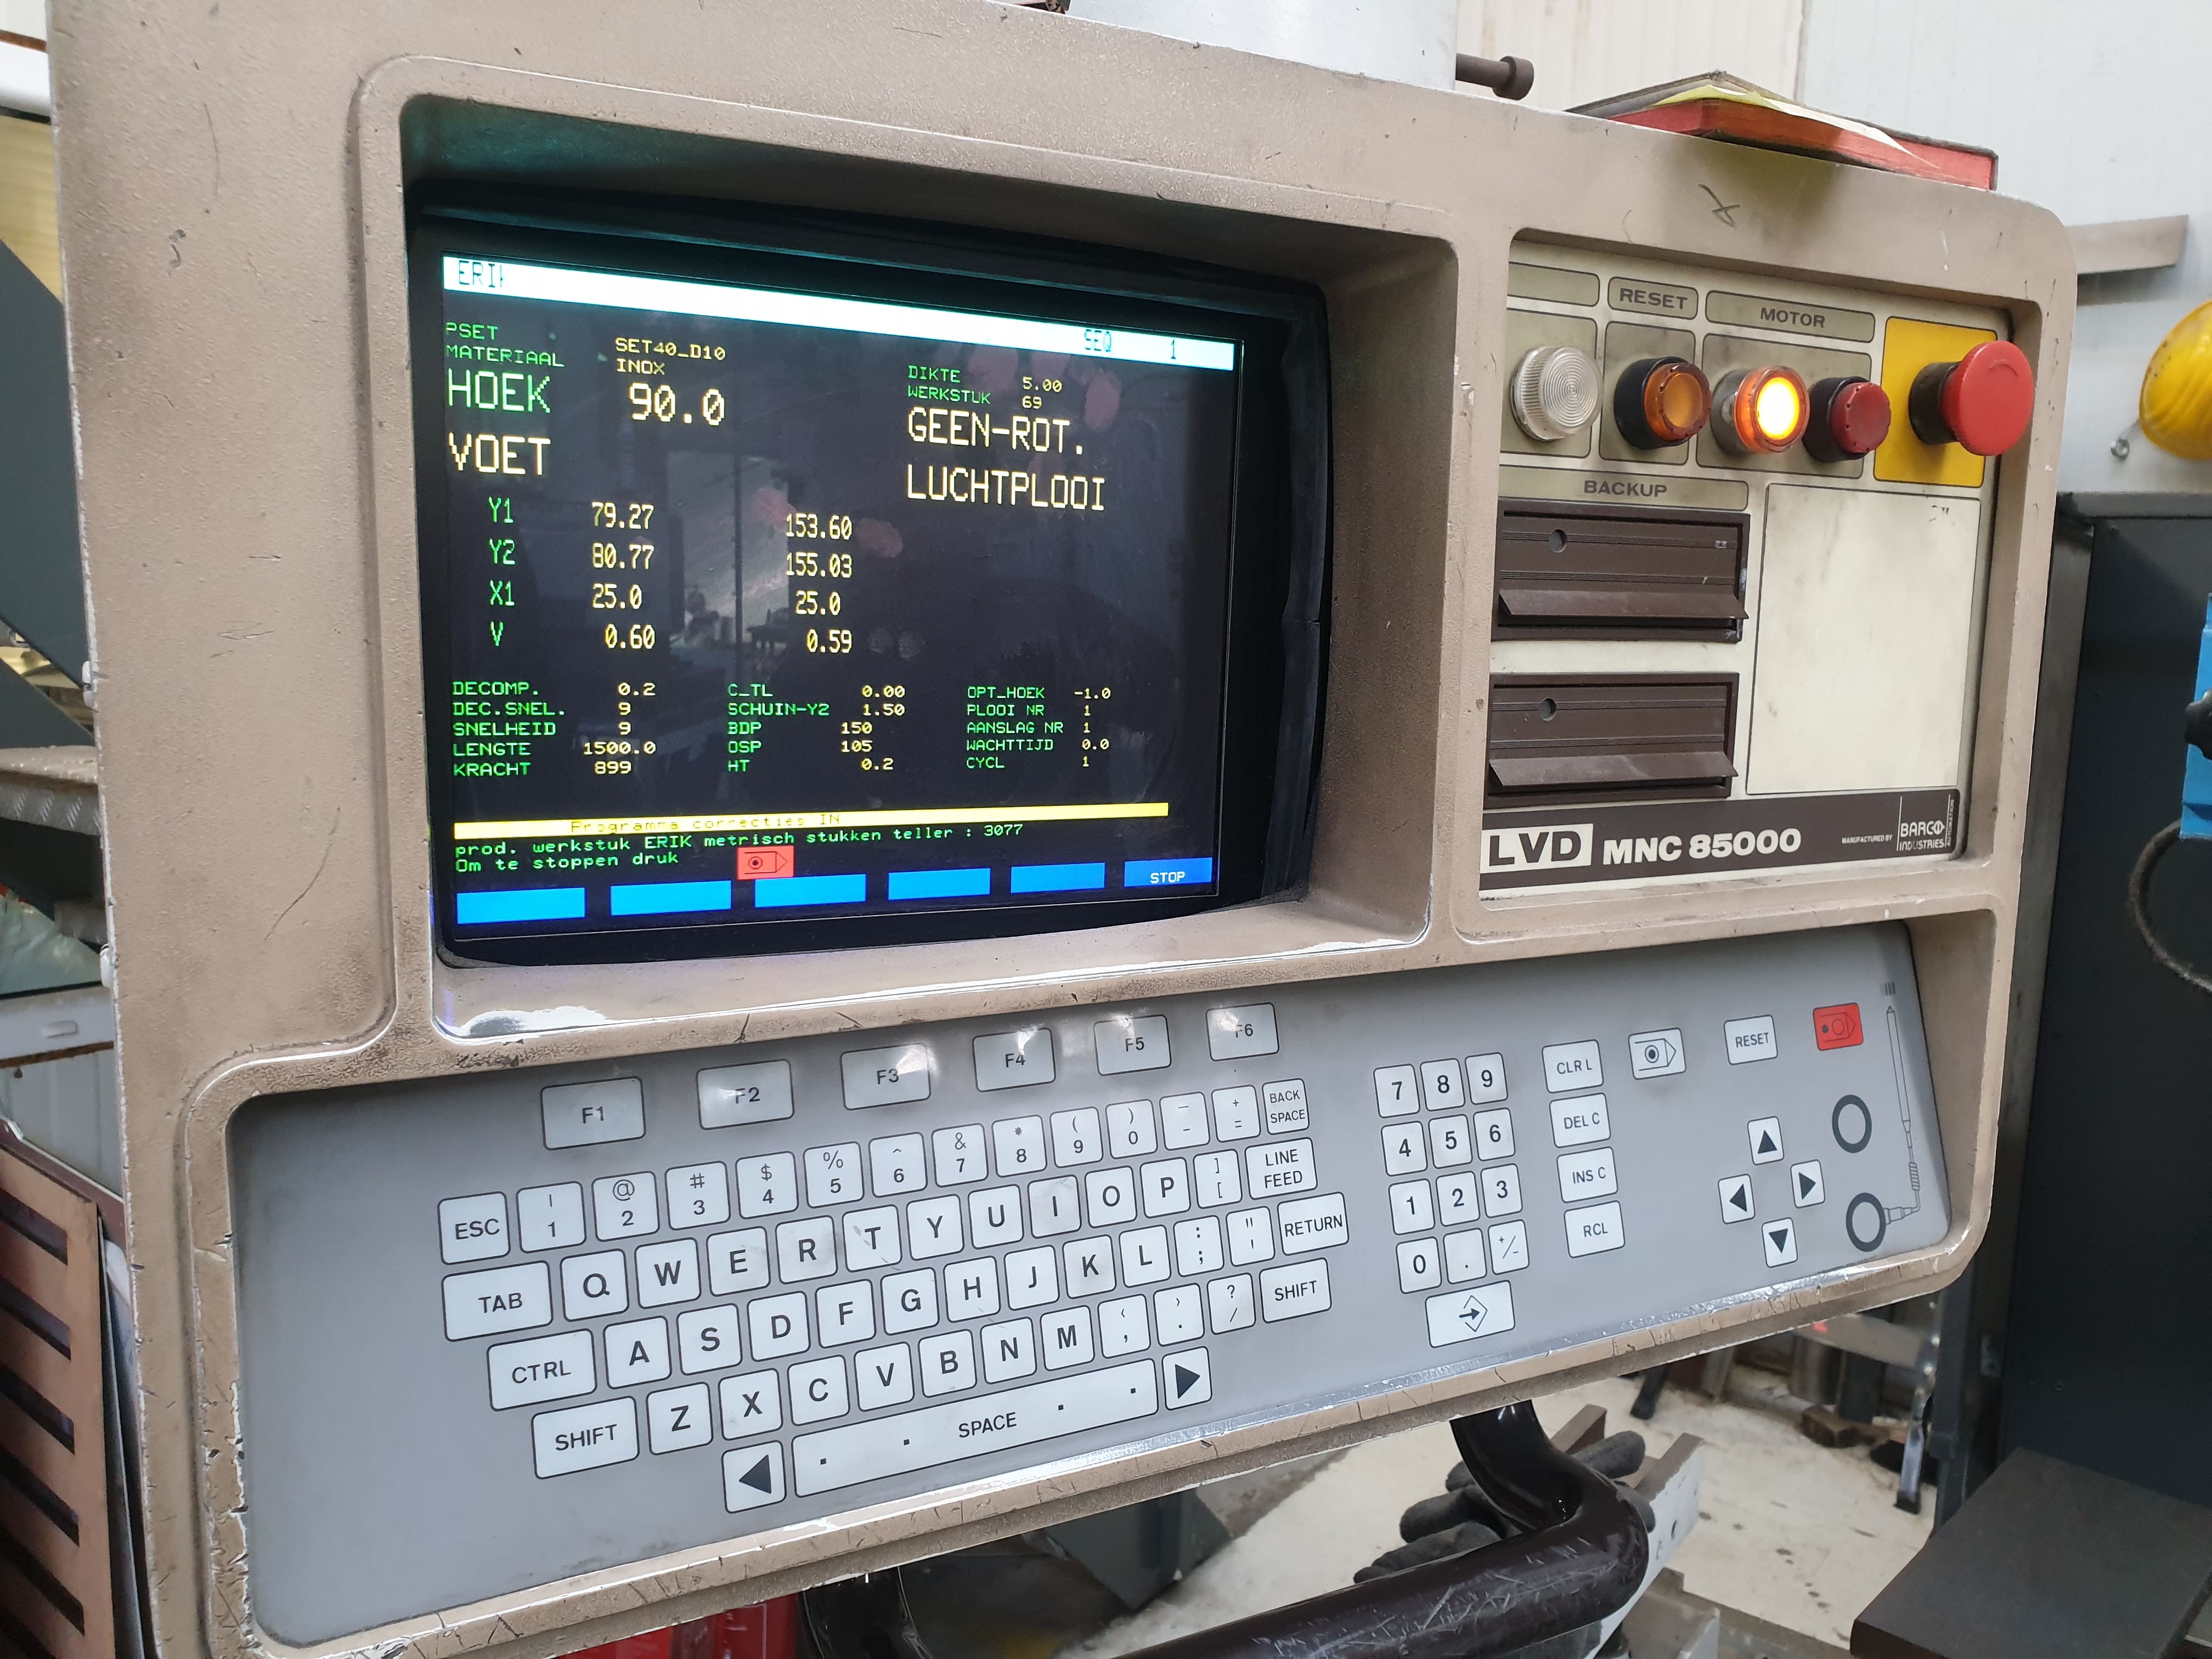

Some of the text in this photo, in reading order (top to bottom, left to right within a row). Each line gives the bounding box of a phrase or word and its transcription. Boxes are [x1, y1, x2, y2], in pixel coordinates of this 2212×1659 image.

[1620, 287, 1688, 310] RESET
[1760, 308, 1826, 329] MOTOR
[445, 322, 499, 340] PSET
[446, 345, 565, 367] MATERIAAL
[616, 337, 726, 360] SET40_D10
[1170, 338, 1177, 360] 1
[617, 358, 665, 375] INOX
[908, 365, 961, 383] DIKTE
[448, 368, 550, 414] HOEK
[1023, 376, 1062, 393] 5.00
[629, 382, 725, 426] 90.0
[908, 385, 991, 404] WERKSTUK
[1022, 395, 1042, 409] 69
[908, 407, 1084, 455] GEEN-ROT.
[449, 432, 551, 476] VOET
[907, 464, 1105, 511] LUCHTPLOOI
[1584, 478, 1667, 497] BACKUP
[488, 496, 514, 523] Y1
[591, 501, 654, 529] 79.27
[785, 512, 852, 540] 153.60
[489, 538, 516, 565] Y2
[592, 543, 654, 569] 80.77
[786, 552, 853, 578] 155.03
[490, 580, 515, 606] X1
[592, 583, 642, 610] 25.0
[795, 590, 840, 616] 25.0
[490, 621, 504, 646] V
[605, 623, 655, 649] 0.60
[806, 629, 852, 653] 0.59
[452, 681, 538, 695] DECOMP.
[618, 682, 656, 696] 0.2
[728, 683, 774, 697] C_TL
[862, 685, 905, 698] 0.00
[968, 686, 1045, 699] OPT_HOEK
[1074, 687, 1111, 699] -1.0
[453, 702, 565, 716] DEC.SNEL.
[618, 702, 631, 715] 9
[728, 702, 830, 716] SCHUIN-Y2
[863, 703, 905, 716] 1.50
[967, 704, 1045, 716] PLOOI NR
[1084, 705, 1091, 716] 1
[453, 722, 556, 736] SNELHEID
[618, 721, 631, 735] 9
[728, 721, 761, 735] BDP
[841, 721, 872, 734] 150
[967, 721, 1063, 733] AANSLAG NR
[1084, 722, 1091, 733] 1
[453, 742, 531, 757] LENGTE
[584, 741, 656, 755] 1500.0
[728, 741, 761, 753] OSP
[841, 740, 873, 753] 105
[966, 739, 1053, 751] WACHTTIJD
[1082, 738, 1109, 750] 0.0
[454, 762, 531, 777] KRACHT
[595, 760, 631, 774] 899
[727, 759, 751, 772] HT
[861, 758, 894, 770] 0.2
[966, 757, 1005, 769] CYCL
[1083, 755, 1089, 767] 1
[571, 814, 840, 835] Programma correcties IN
[1900, 820, 1945, 837] BARCO
[455, 823, 1023, 858] prod. werkstuk ERIK metrisch stukken teller 3077
[1488, 831, 1581, 867] LVD
[1602, 828, 1801, 865] MNC 85000
[1842, 835, 1884, 844] MANUFACTURED
[1900, 839, 1944, 850] INDUSTRIES
[456, 851, 679, 872] Om te stoppen druk
[1150, 871, 1185, 884] STOP
[1235, 1023, 1254, 1038] F6
[1735, 1032, 1769, 1048] RESET
[1125, 1036, 1145, 1052] F5
[1005, 1053, 1026, 1068] F4
[1556, 1059, 1593, 1075] CLR L
[876, 1068, 899, 1085] F3
[1437, 1075, 1450, 1094] 8
[1481, 1069, 1493, 1088] 9
[735, 1086, 761, 1104] F2
[1269, 1090, 1300, 1104] BACK
[1391, 1081, 1402, 1101] 7
[582, 1105, 604, 1124] F1
[1270, 1109, 1306, 1124] SPACE
[1564, 1112, 1600, 1130] DEL C
[1128, 1131, 1138, 1145] 0
[1489, 1124, 1501, 1143] 6
[1016, 1148, 1027, 1163] 8
[1073, 1139, 1084, 1154] 9
[1399, 1138, 1412, 1157] 4
[1265, 1149, 1299, 1166] LINE
[894, 1168, 905, 1183] 6
[1264, 1170, 1302, 1189] FEED
[1572, 1166, 1606, 1184] INS C
[830, 1178, 842, 1194] 5
[1160, 1176, 1175, 1198] P
[1496, 1180, 1508, 1199] 3
[1102, 1185, 1120, 1207] O
[1452, 1188, 1465, 1207] 2
[693, 1199, 706, 1215] 3
[988, 1204, 1005, 1228] U
[621, 1210, 634, 1227] 2
[926, 1215, 943, 1239] Y
[1284, 1214, 1343, 1237] RETURN
[455, 1218, 500, 1240] ESC
[864, 1226, 881, 1250] T
[1583, 1222, 1609, 1238] RCL
[798, 1238, 817, 1262] R
[1138, 1245, 1153, 1266] L
[729, 1249, 748, 1274] E
[1082, 1254, 1099, 1278] K
[1413, 1254, 1426, 1274] 0
[653, 1260, 681, 1286] W
[583, 1273, 610, 1298] Q
[963, 1276, 981, 1301] H
[1274, 1280, 1317, 1301] SHIFT
[478, 1293, 523, 1313] TAB
[901, 1289, 921, 1312] G
[838, 1301, 853, 1325] F
[771, 1314, 791, 1339] D
[701, 1327, 720, 1352] S
[1057, 1324, 1077, 1350] M
[629, 1340, 650, 1366] A
[1000, 1337, 1019, 1362] N
[940, 1350, 958, 1374] B
[512, 1360, 572, 1384] CTRL
[876, 1362, 894, 1387] V
[809, 1378, 829, 1402] C
[742, 1391, 763, 1418] X
[670, 1405, 691, 1432] Z
[958, 1412, 1017, 1438] SPACE
[555, 1424, 617, 1451] SHIFT
